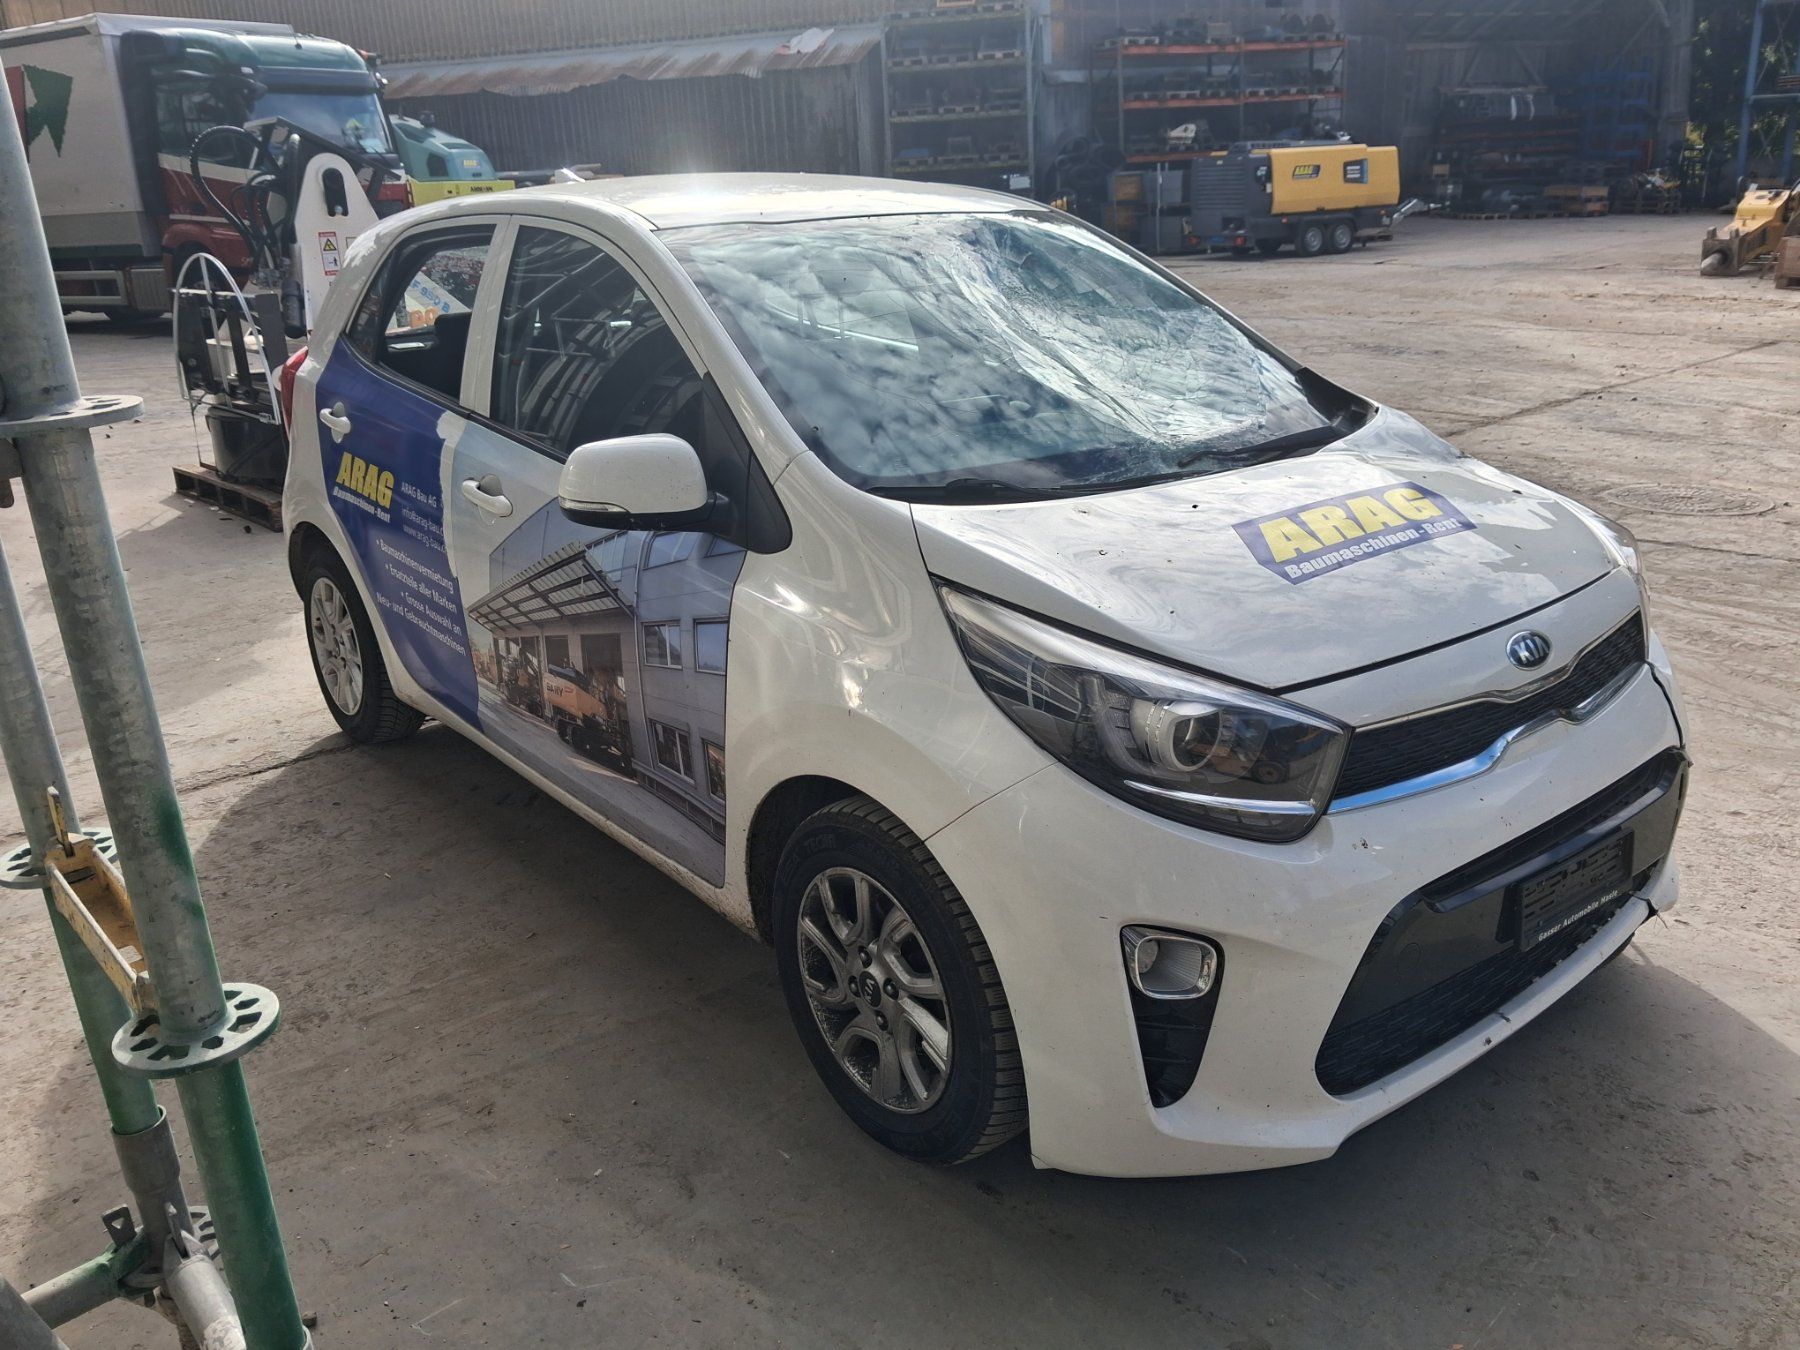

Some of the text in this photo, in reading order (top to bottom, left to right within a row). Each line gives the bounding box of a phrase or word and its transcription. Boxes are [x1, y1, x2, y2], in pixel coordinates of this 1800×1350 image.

[335, 451, 395, 509] ARAG
[401, 482, 417, 498] ARAG
[417, 489, 428, 504] Bau
[428, 494, 437, 508] AG
[1258, 487, 1443, 563] ARAG
[1284, 517, 1462, 579] Baumaschinen-Rent
[392, 602, 405, 616] und
[419, 582, 432, 598] aller
[432, 589, 458, 614] Marken
[426, 604, 453, 631] Auswahl
[452, 625, 462, 636] an
[1563, 900, 1599, 927] Automobile
